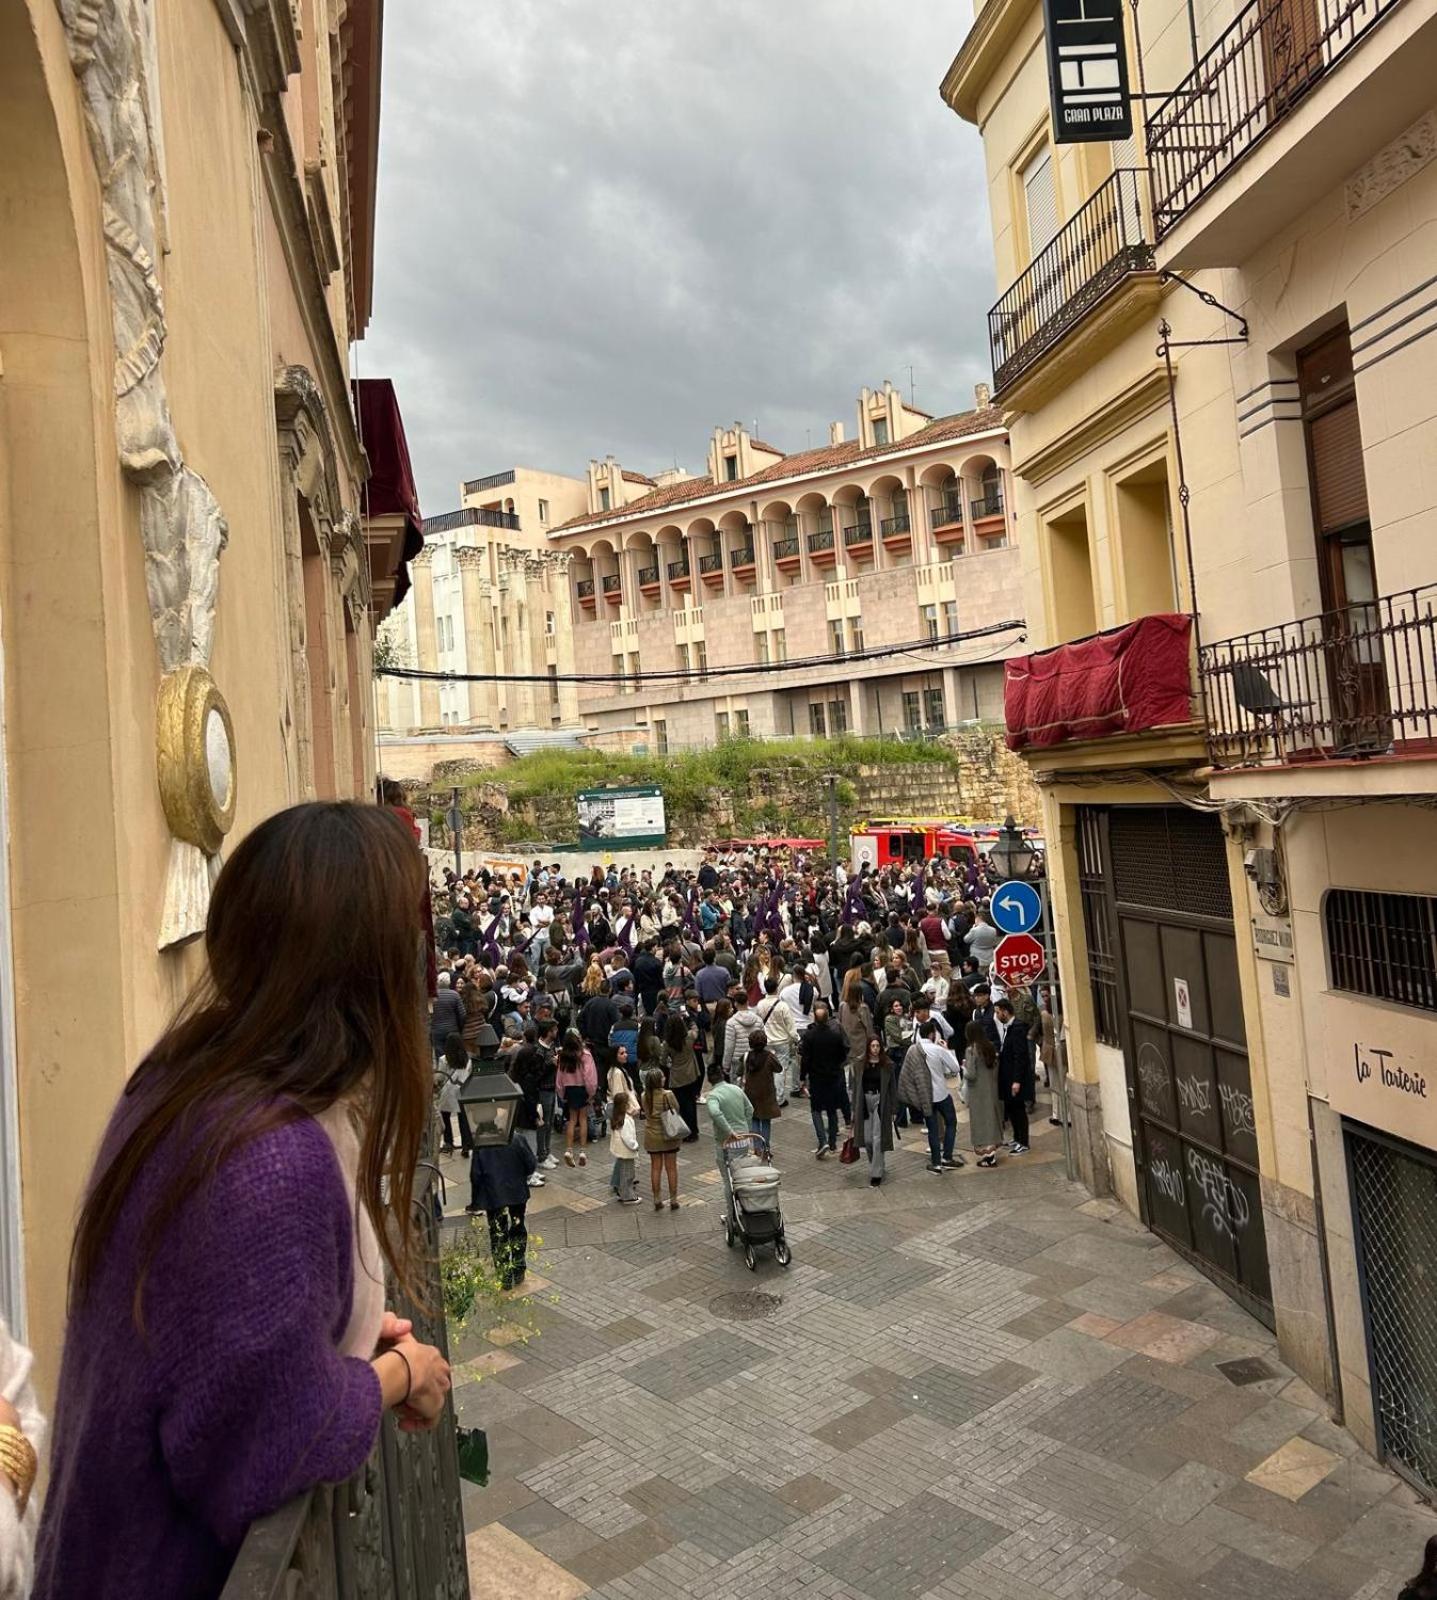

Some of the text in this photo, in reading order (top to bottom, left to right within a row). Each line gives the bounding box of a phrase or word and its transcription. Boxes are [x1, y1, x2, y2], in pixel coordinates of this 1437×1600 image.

[1064, 106, 1123, 123] GRAN PLAZA
[1000, 953, 1039, 968] STOP
[1369, 1048, 1427, 1098] Tarterie
